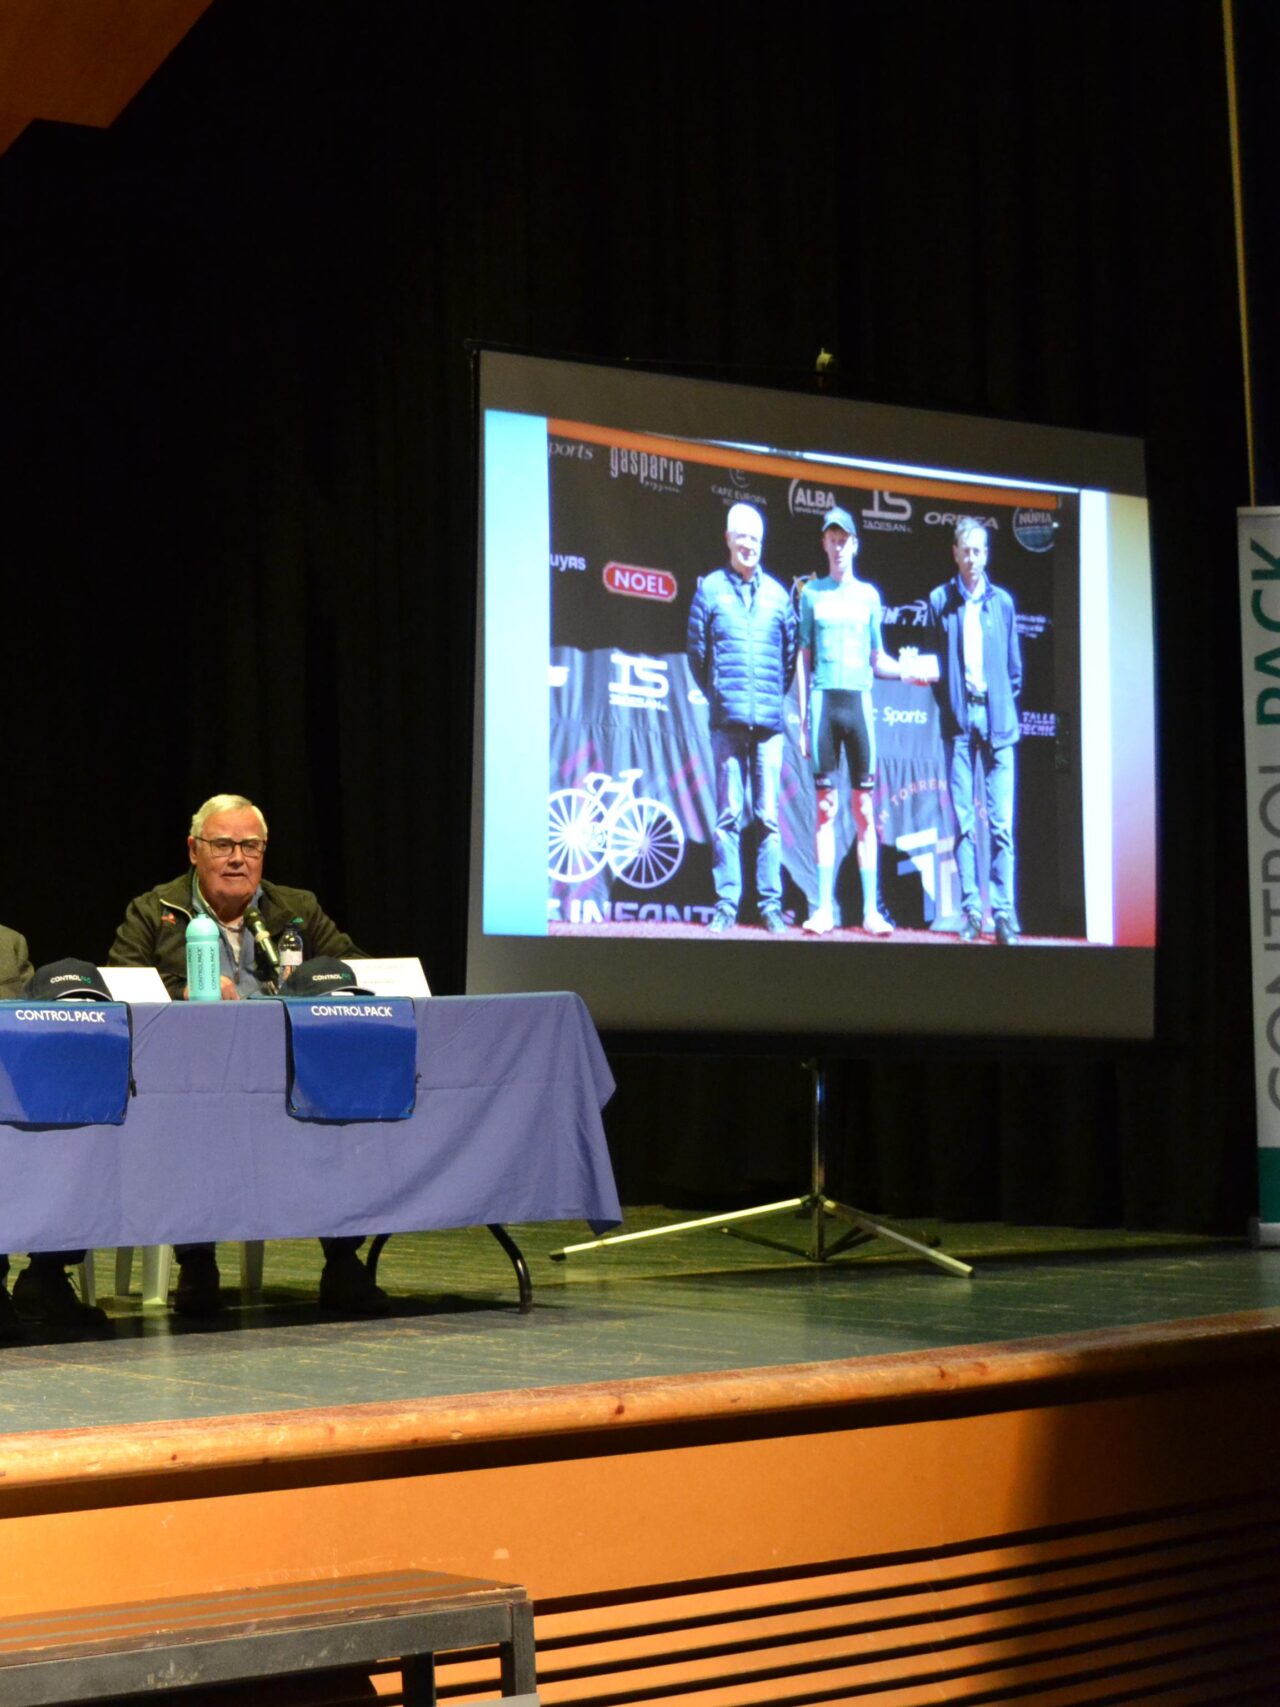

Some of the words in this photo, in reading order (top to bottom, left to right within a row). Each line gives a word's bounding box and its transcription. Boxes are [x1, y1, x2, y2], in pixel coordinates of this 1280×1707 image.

[795, 487, 835, 509] ALBA
[614, 569, 669, 595] NOEL
[883, 706, 927, 726] Sports
[15, 1009, 106, 1023] CONTROLPACK
[311, 1005, 393, 1017] CONTROLPACK
